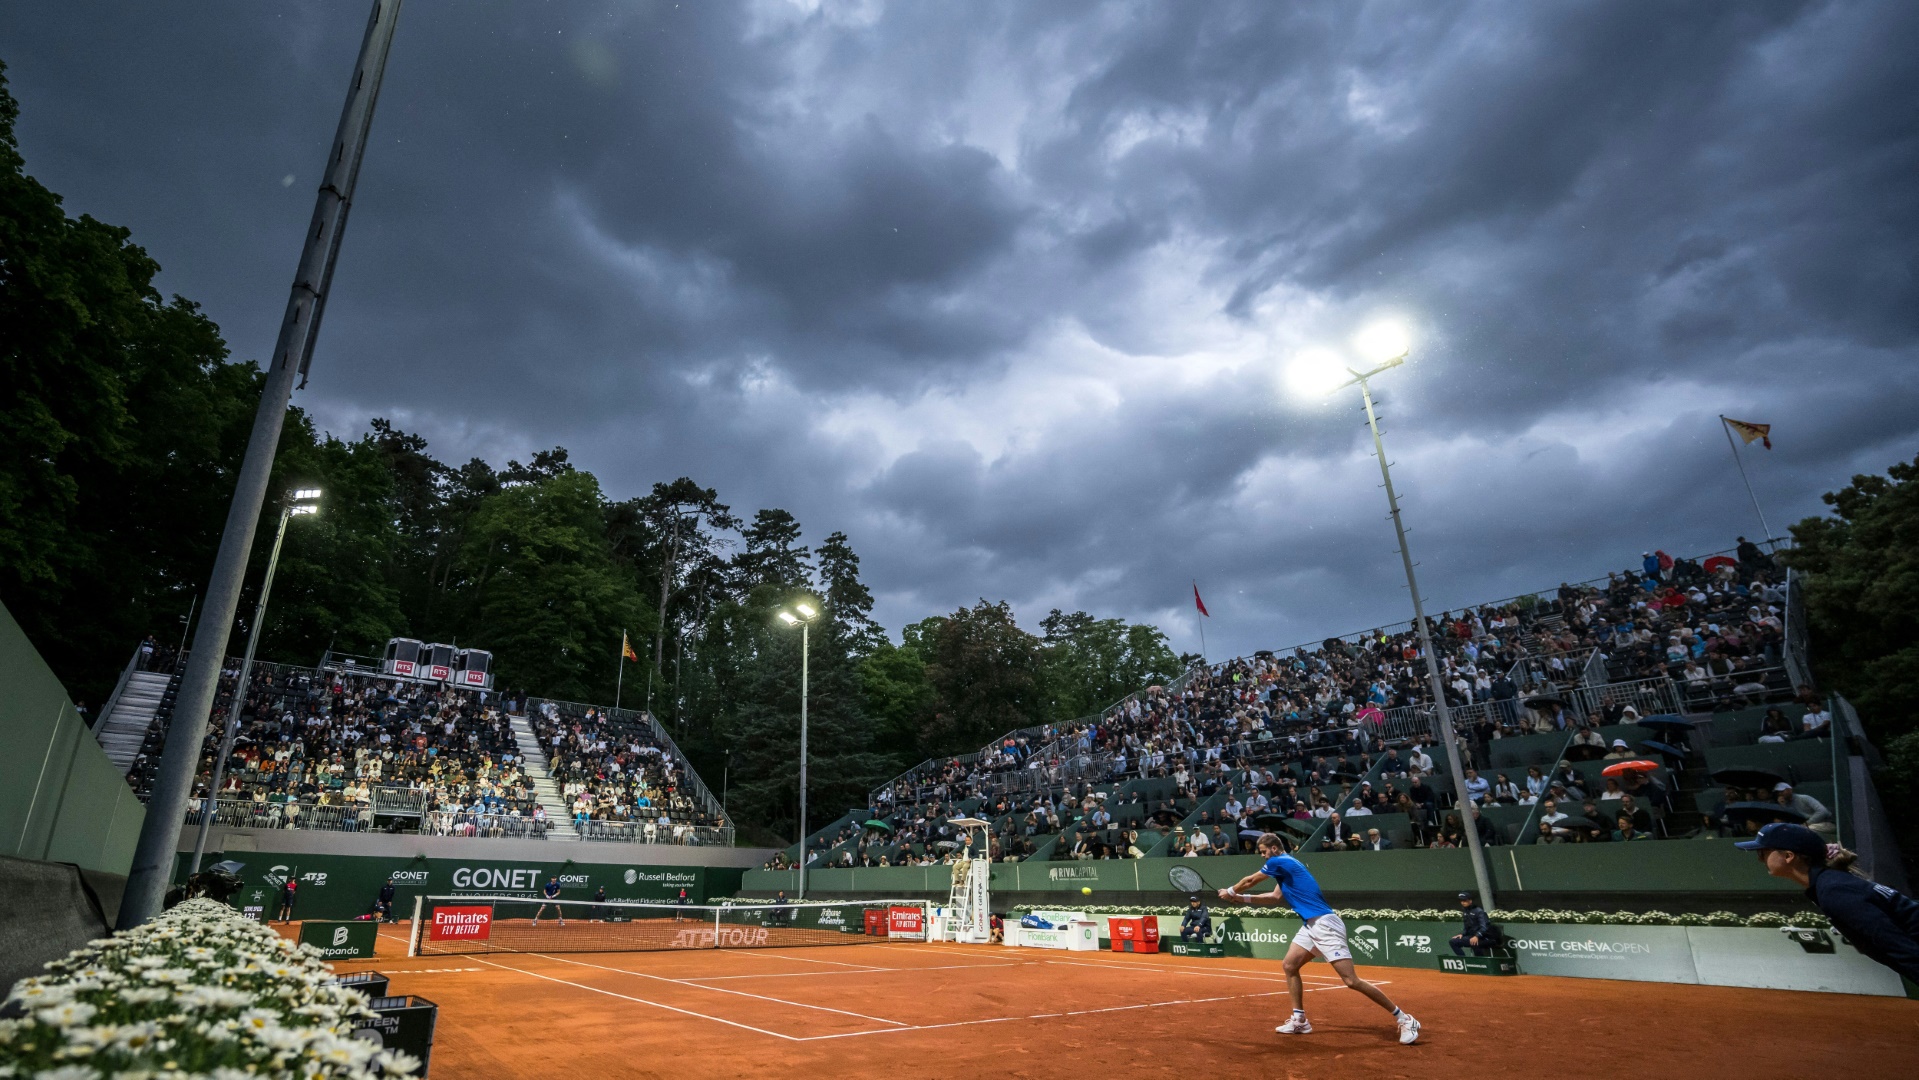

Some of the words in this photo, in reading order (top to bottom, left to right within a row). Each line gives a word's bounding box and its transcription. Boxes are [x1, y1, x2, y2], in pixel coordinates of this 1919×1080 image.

[300, 872, 328, 880] ATP
[392, 871, 429, 880] GONET
[452, 868, 542, 888] GONET
[638, 872, 665, 881] Russell
[666, 872, 695, 881] Bedford
[436, 912, 488, 924] Emirates
[892, 910, 920, 920] Emirates
[442, 925, 454, 935] FLY
[455, 924, 480, 935] BETTER
[671, 929, 715, 947] ATP
[720, 928, 768, 946] TOUR
[1226, 928, 1288, 943] vaudoise
[1395, 934, 1431, 947] ATP
[1173, 944, 1186, 954] m3
[1354, 936, 1374, 952] GONET
[1508, 940, 1556, 950] GONET
[1443, 958, 1464, 970] m3
[385, 1026, 398, 1034] TM
